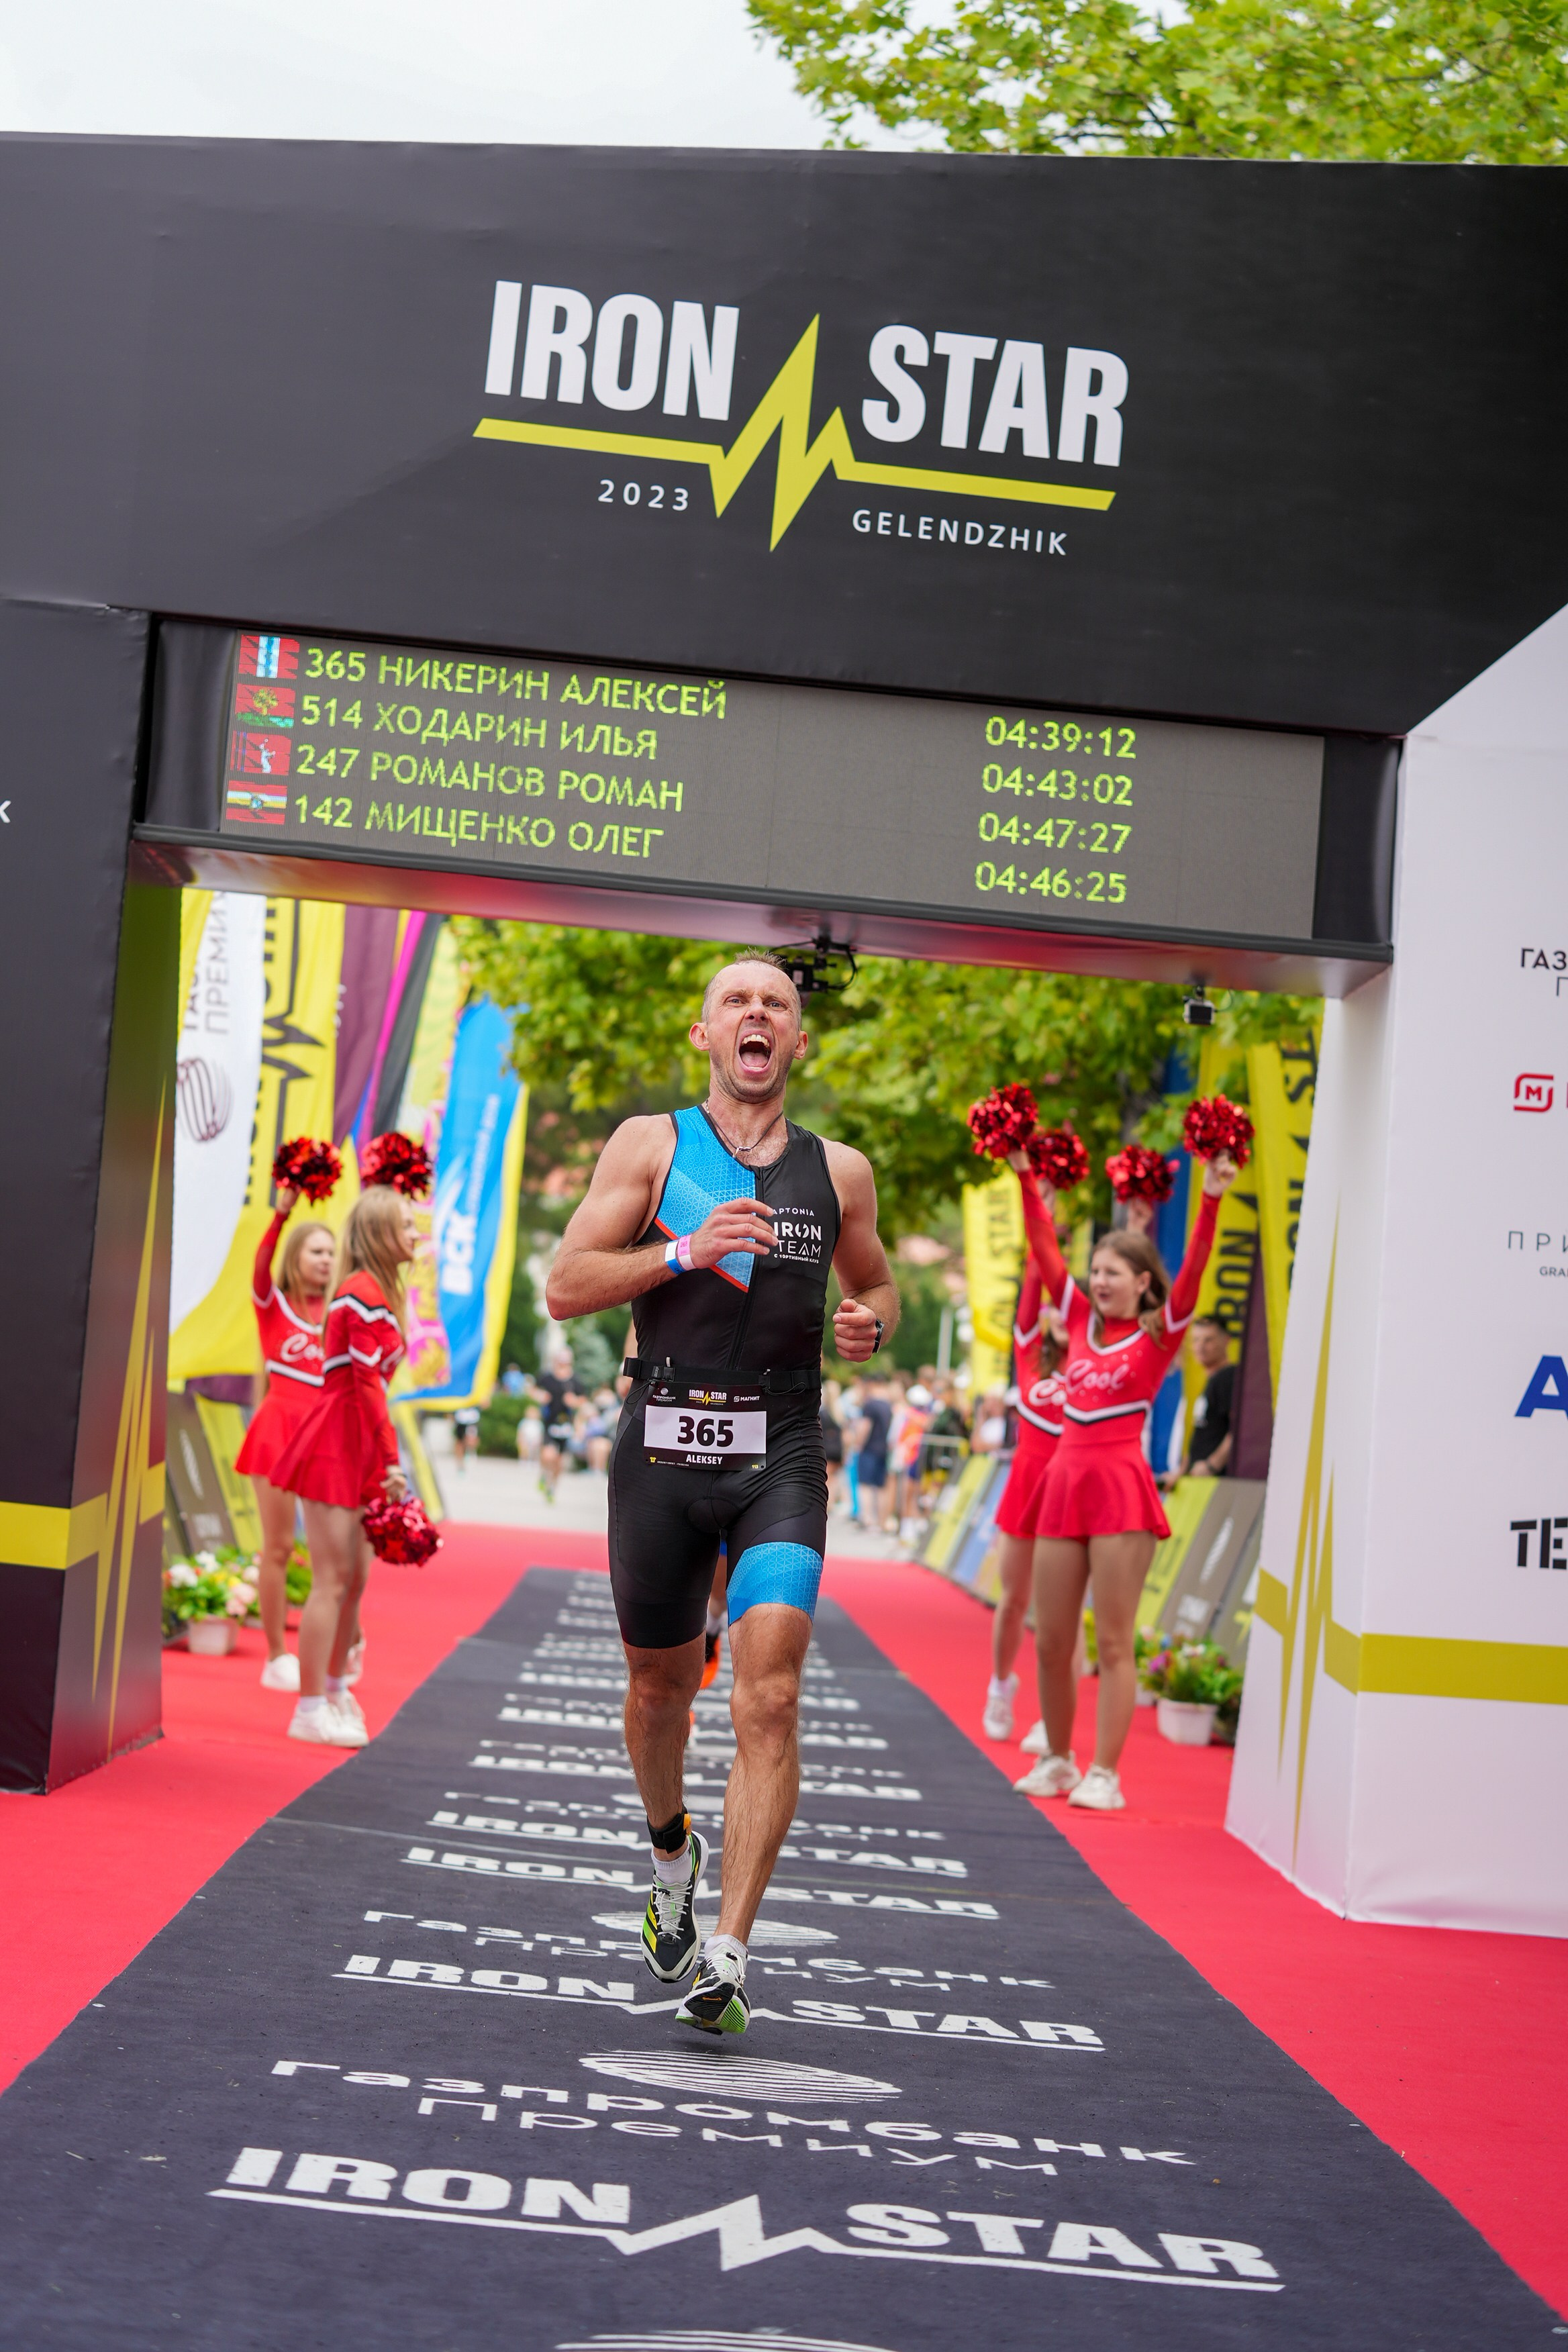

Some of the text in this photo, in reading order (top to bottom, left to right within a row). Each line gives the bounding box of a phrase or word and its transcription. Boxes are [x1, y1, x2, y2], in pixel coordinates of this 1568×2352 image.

[484, 281, 1129, 467] IRON STAR
[598, 479, 690, 511] 2023
[852, 509, 1068, 556] GELENDZHIK
[305, 647, 1137, 759] 365 НИКЕРИН АЛЕКСЕЙ 04:39:12
[301, 694, 1133, 806] 514 ХОДАРИН ИЛЬЯ 04:43:02
[296, 743, 1132, 854] 247 РОМАНОВ РОМАН 04:47:27
[295, 793, 1127, 903] 142 МИЩЕНКО ОЛЕГ 04:46:25
[205, 891, 230, 1035] ПРЕМИ
[773, 1208, 815, 1217] APTONIA
[773, 1222, 822, 1241] IRON
[777, 1240, 822, 1258] TEAM
[1539, 1265, 1568, 1277] GRA
[689, 1389, 727, 1400] IRON STAR
[1065, 1359, 1130, 1394] Cool
[677, 1416, 734, 1447] 365
[686, 1454, 723, 1465] ALEKSEY
[432, 1810, 640, 1843] IRON
[407, 1847, 634, 1885] IRON
[344, 1954, 1103, 2045] IRON STAR
[271, 2060, 1197, 2165] Газпромбанк
[418, 2098, 1059, 2175] Премиум
[226, 2147, 1279, 2278] IRON STAR
